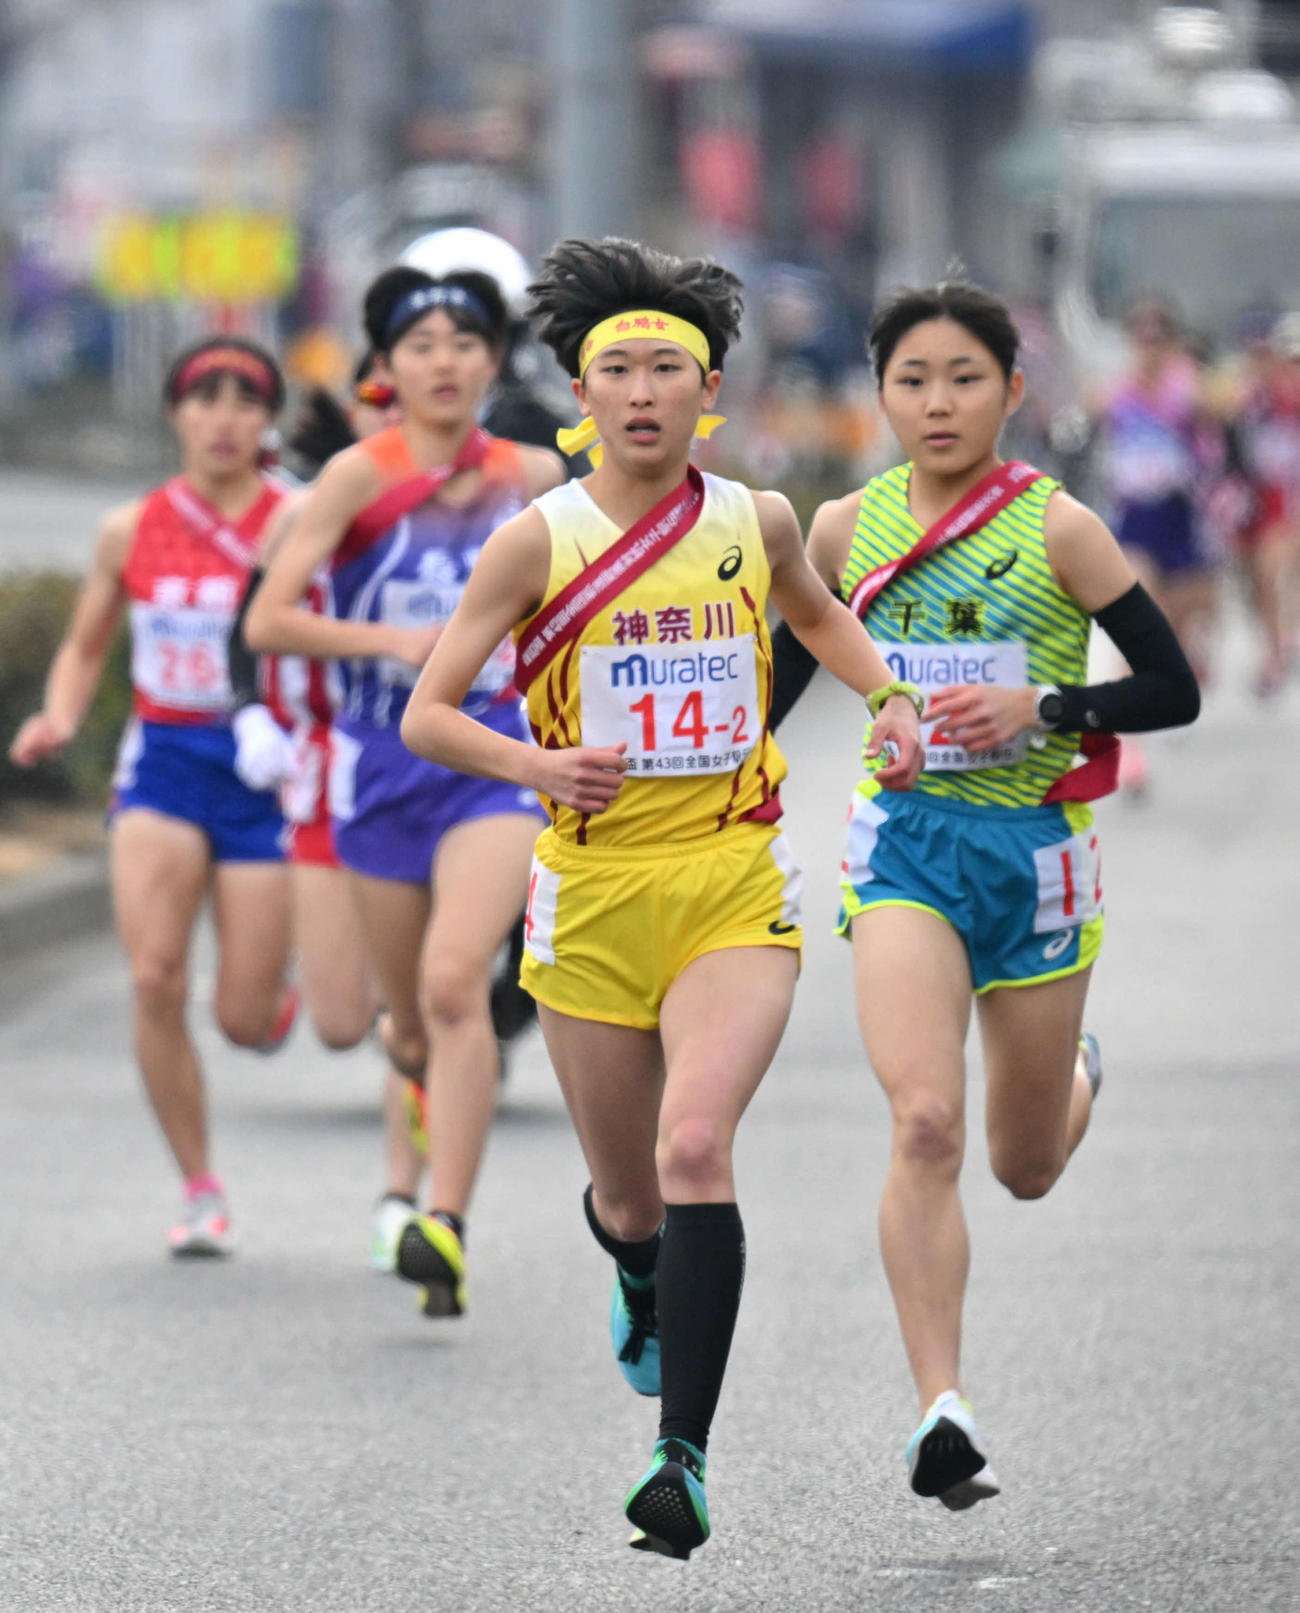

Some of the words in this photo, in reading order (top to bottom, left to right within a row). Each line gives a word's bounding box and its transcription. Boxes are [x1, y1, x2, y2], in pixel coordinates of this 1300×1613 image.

[611, 602, 735, 646] 神奈川
[888, 598, 985, 636] 千葉
[629, 690, 749, 751] 14-2
